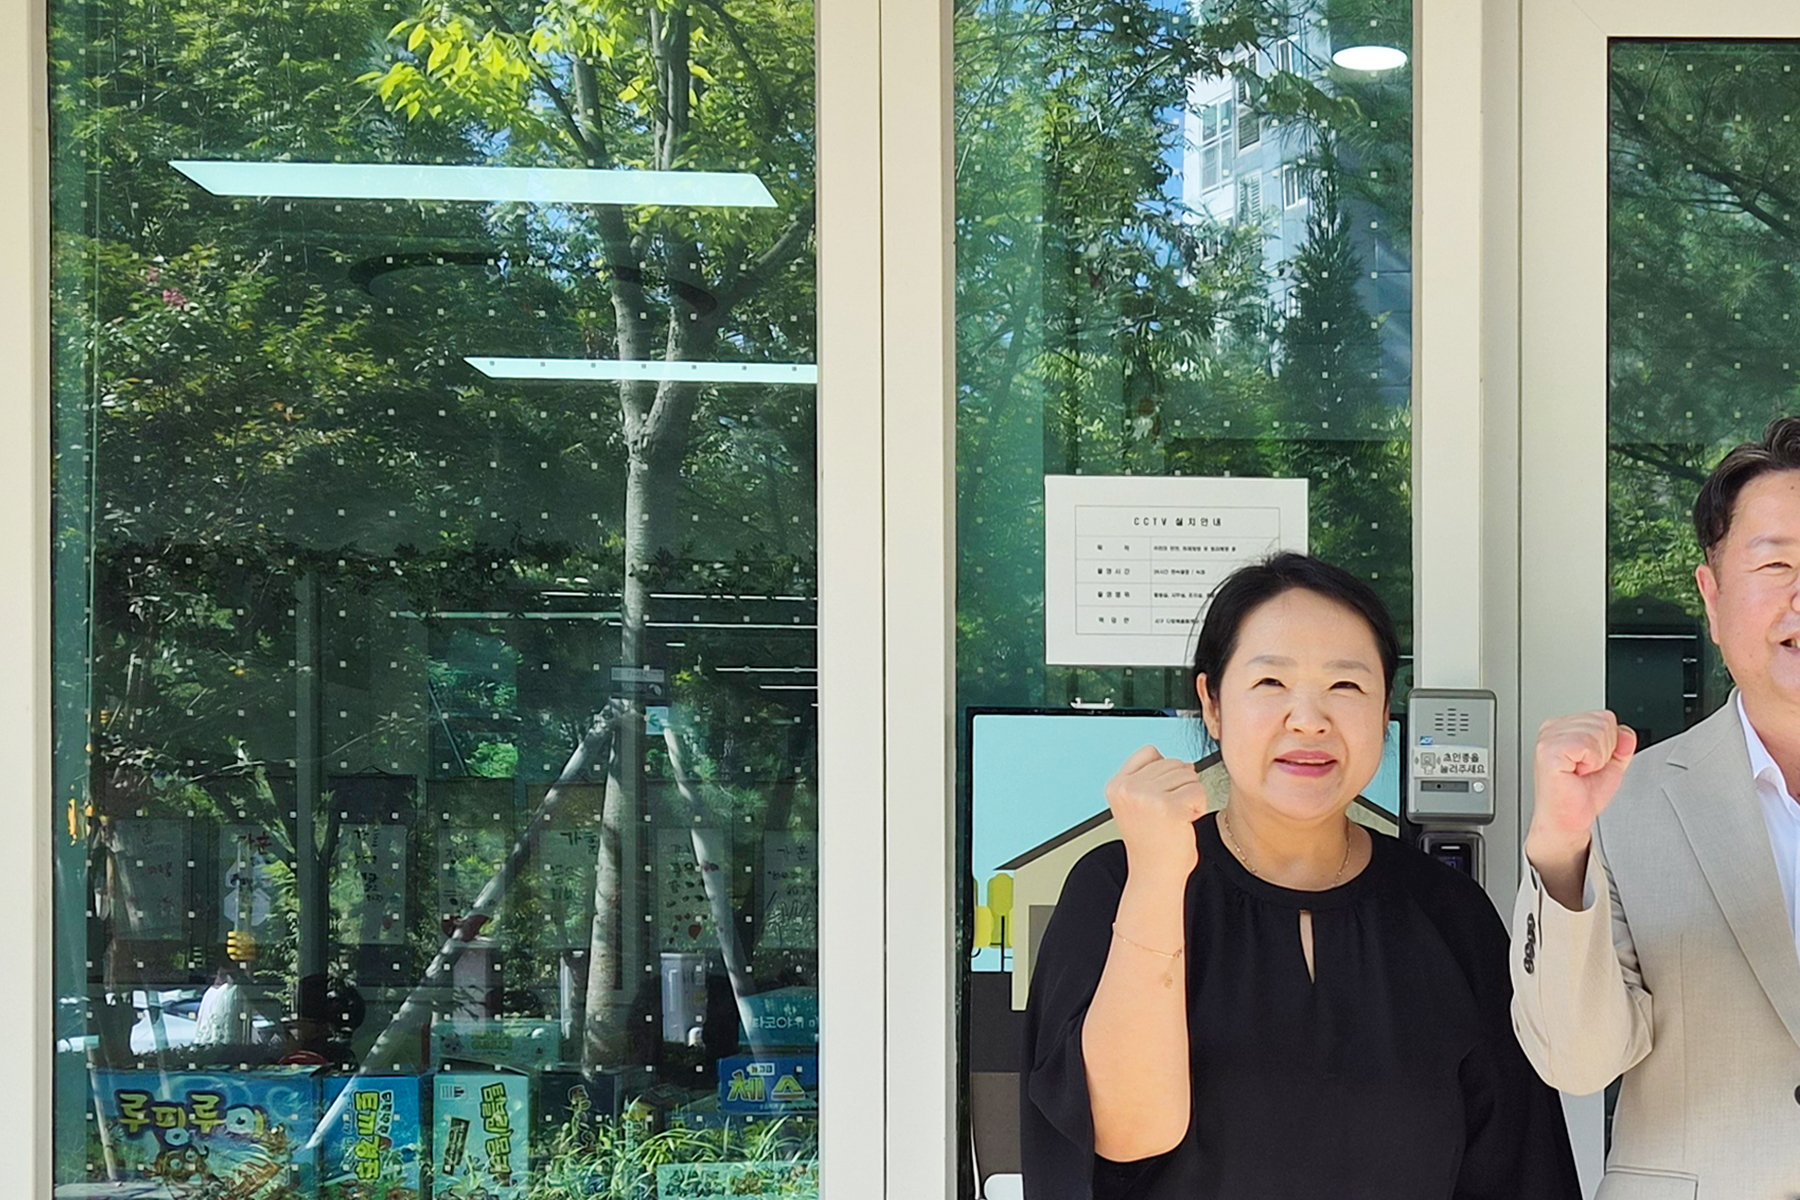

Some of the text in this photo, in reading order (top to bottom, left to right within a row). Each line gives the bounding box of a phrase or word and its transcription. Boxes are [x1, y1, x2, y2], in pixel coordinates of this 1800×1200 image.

[1133, 517, 1167, 526] CCTV
[1443, 752, 1479, 763] 초인종을
[1440, 764, 1486, 774] 눌러주세요
[726, 1069, 807, 1101] 체스
[118, 1092, 267, 1146] 루핑루이
